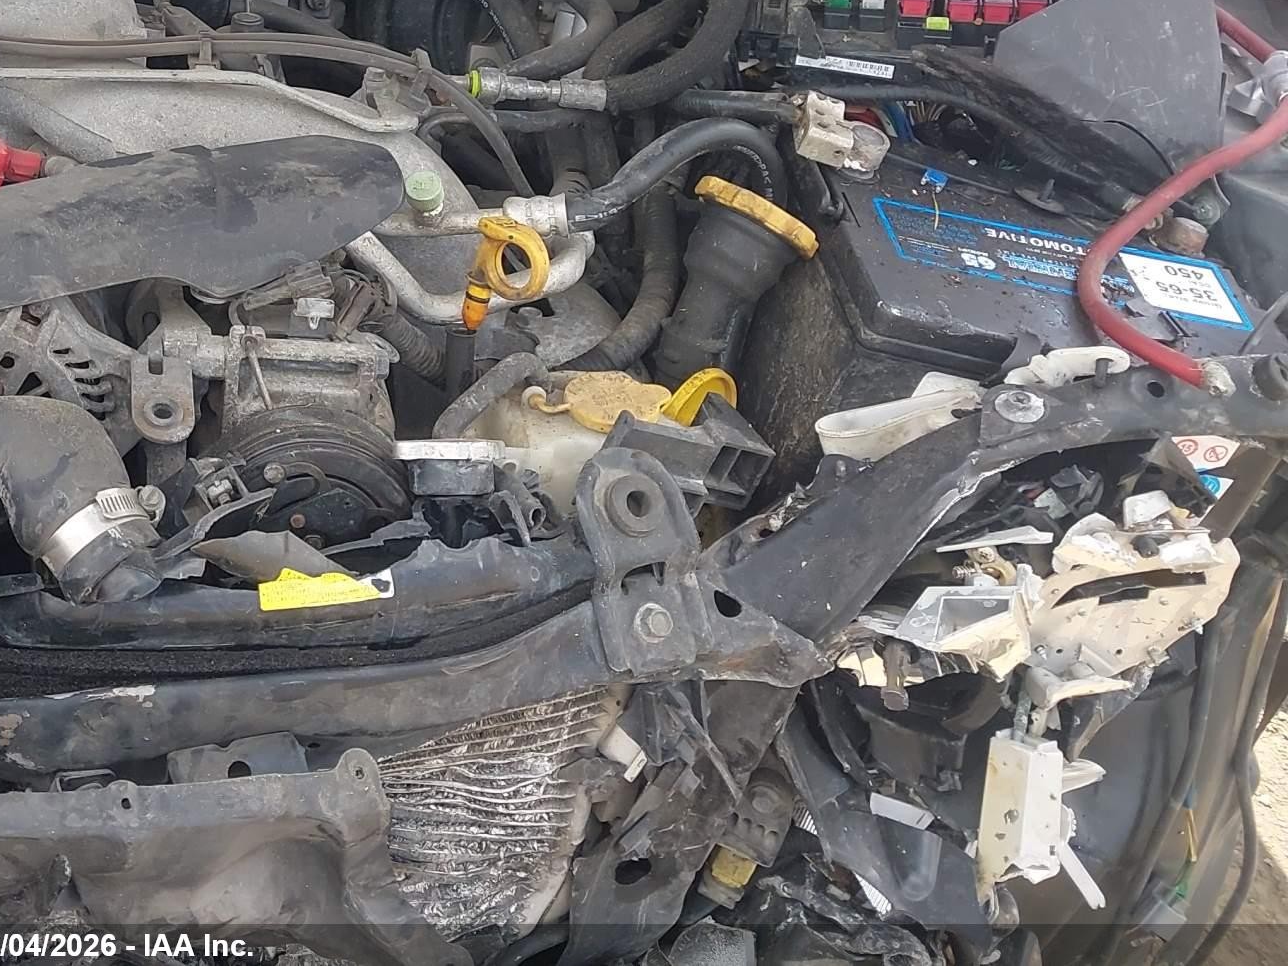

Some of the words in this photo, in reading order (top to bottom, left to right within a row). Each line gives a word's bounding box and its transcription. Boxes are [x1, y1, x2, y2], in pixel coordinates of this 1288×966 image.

[984, 227, 1091, 257] TOMOTIVE
[961, 252, 997, 271] 65
[1164, 265, 1203, 280] 450
[1155, 281, 1218, 302] 35-65
